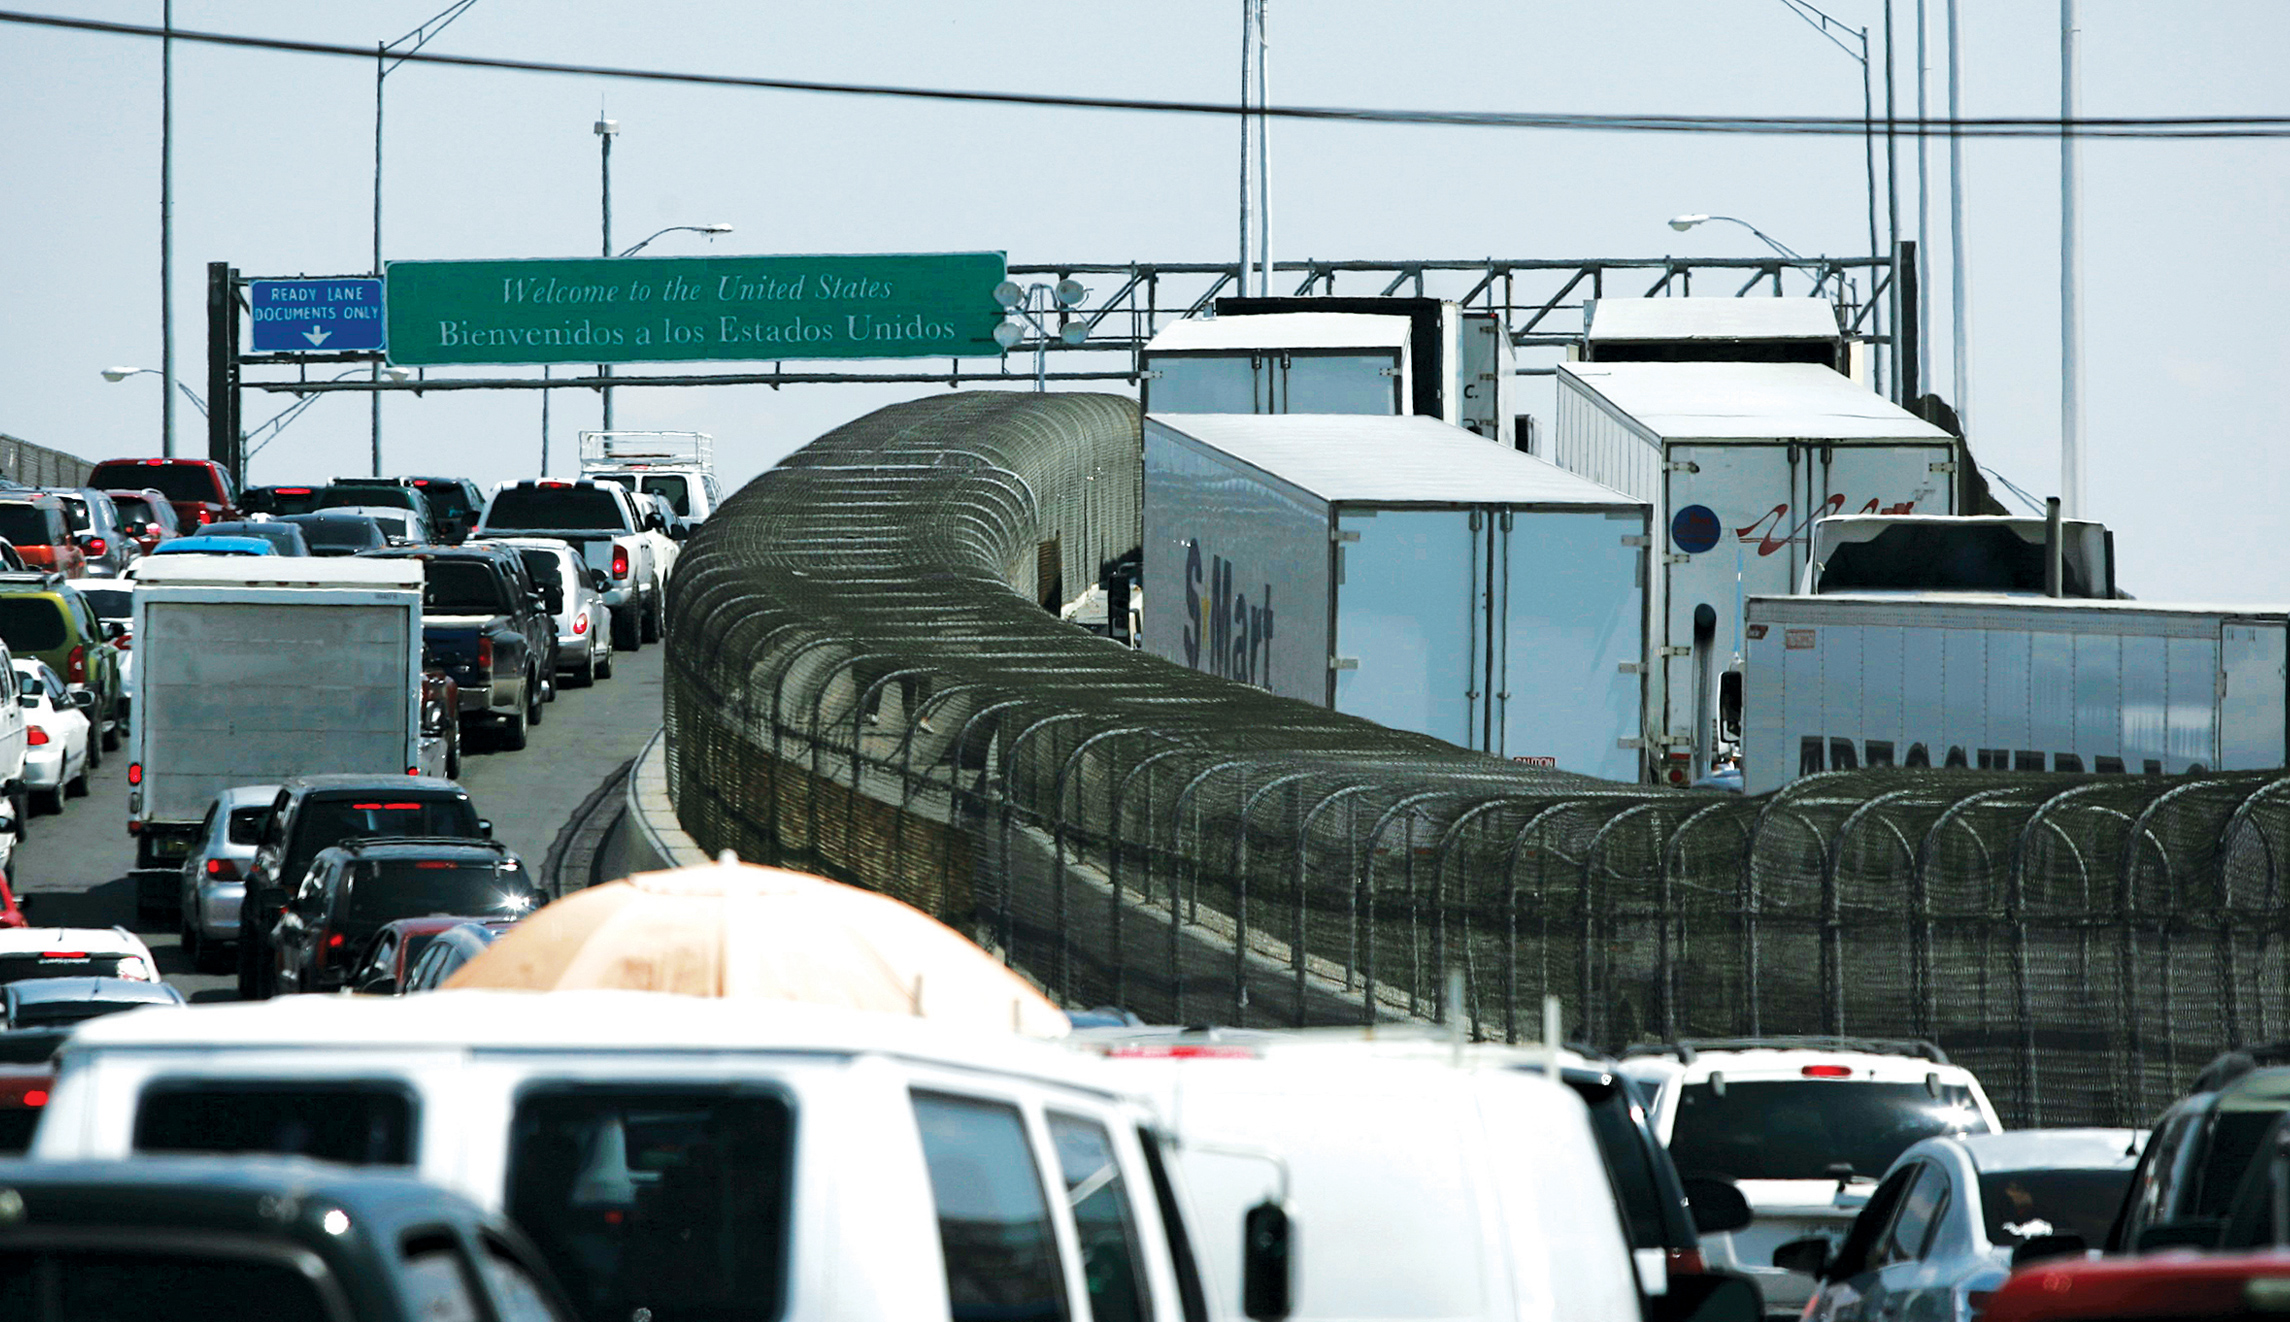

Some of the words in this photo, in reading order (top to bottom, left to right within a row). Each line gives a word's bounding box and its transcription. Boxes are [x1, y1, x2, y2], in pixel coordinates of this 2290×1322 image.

[271, 287, 317, 302] READY
[328, 286, 363, 301] LANE
[503, 277, 618, 303] Welcome
[629, 280, 651, 302] to
[663, 275, 701, 301] the
[718, 274, 804, 301] United
[815, 273, 893, 299] States
[254, 306, 337, 321] DOCUMENTS
[343, 305, 379, 320] ONLY
[438, 319, 624, 347] Bienvenidos
[635, 327, 651, 345] a
[665, 318, 704, 343] los
[719, 315, 834, 342] Estados
[848, 313, 956, 341] Unidos
